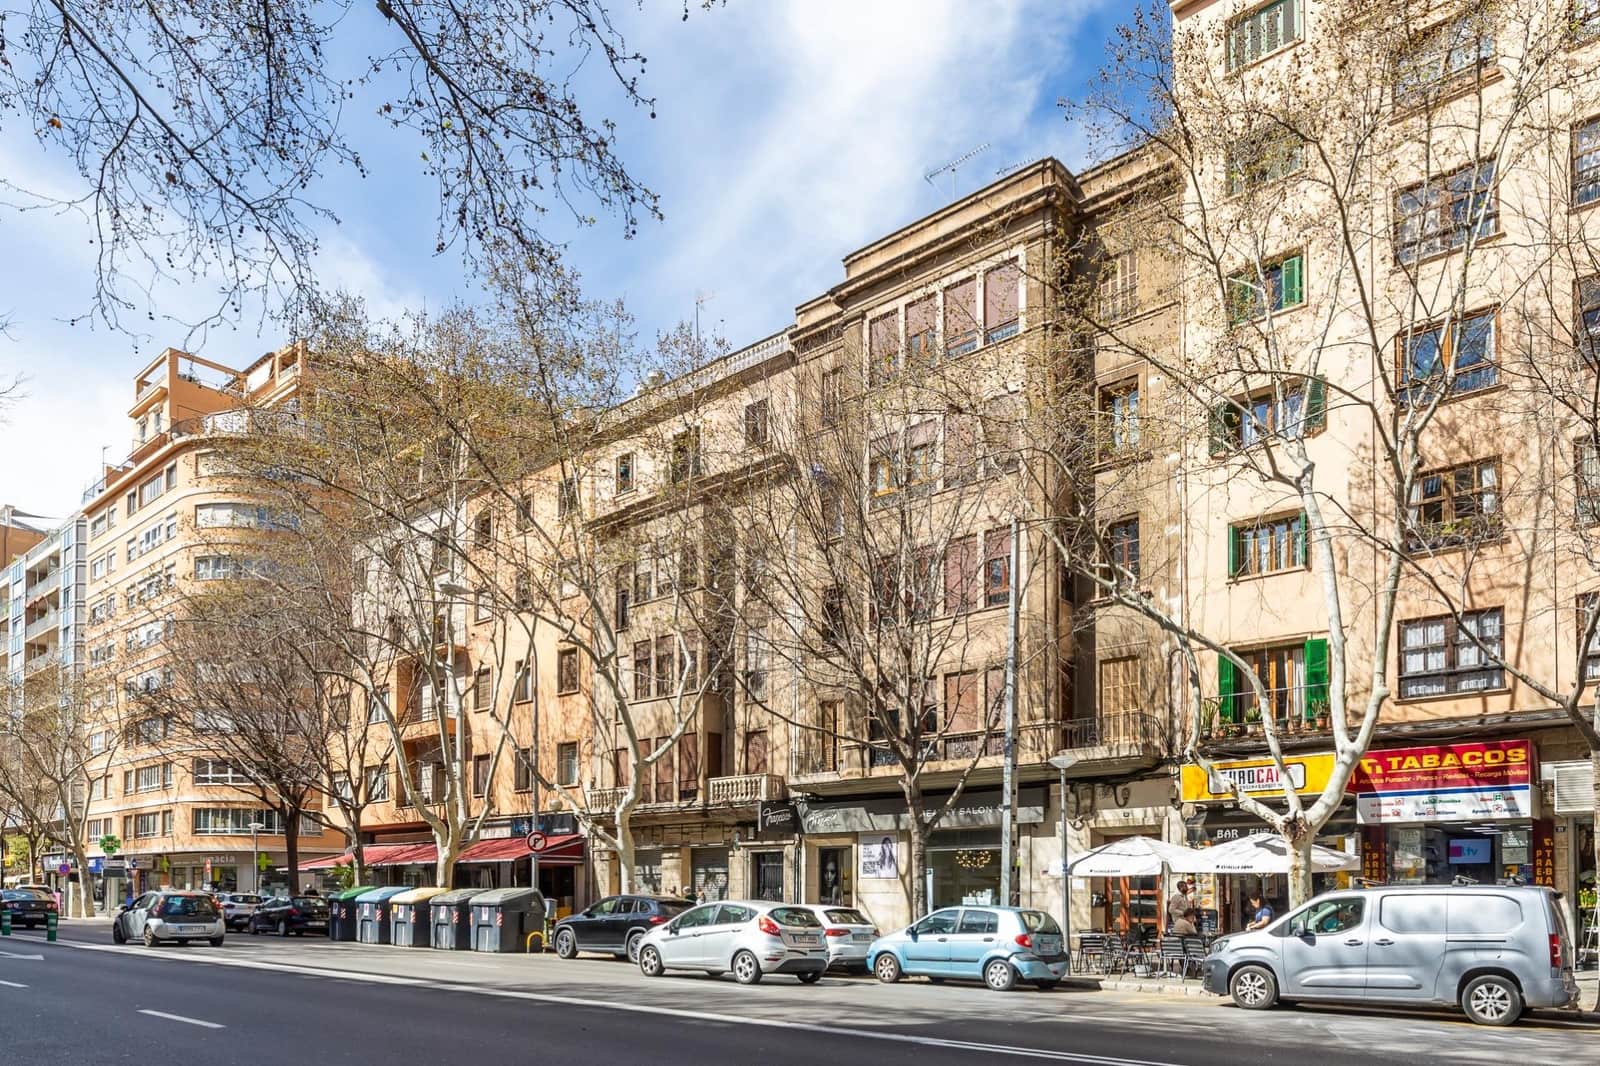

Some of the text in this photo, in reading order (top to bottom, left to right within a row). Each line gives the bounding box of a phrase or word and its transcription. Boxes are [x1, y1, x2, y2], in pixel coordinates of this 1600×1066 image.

[1387, 748, 1527, 770] TABACOS
[1385, 775, 1412, 784] Fumador
[1474, 770, 1503, 780] Recarga
[959, 805, 994, 816] SALON
[1216, 829, 1240, 839] BAR
